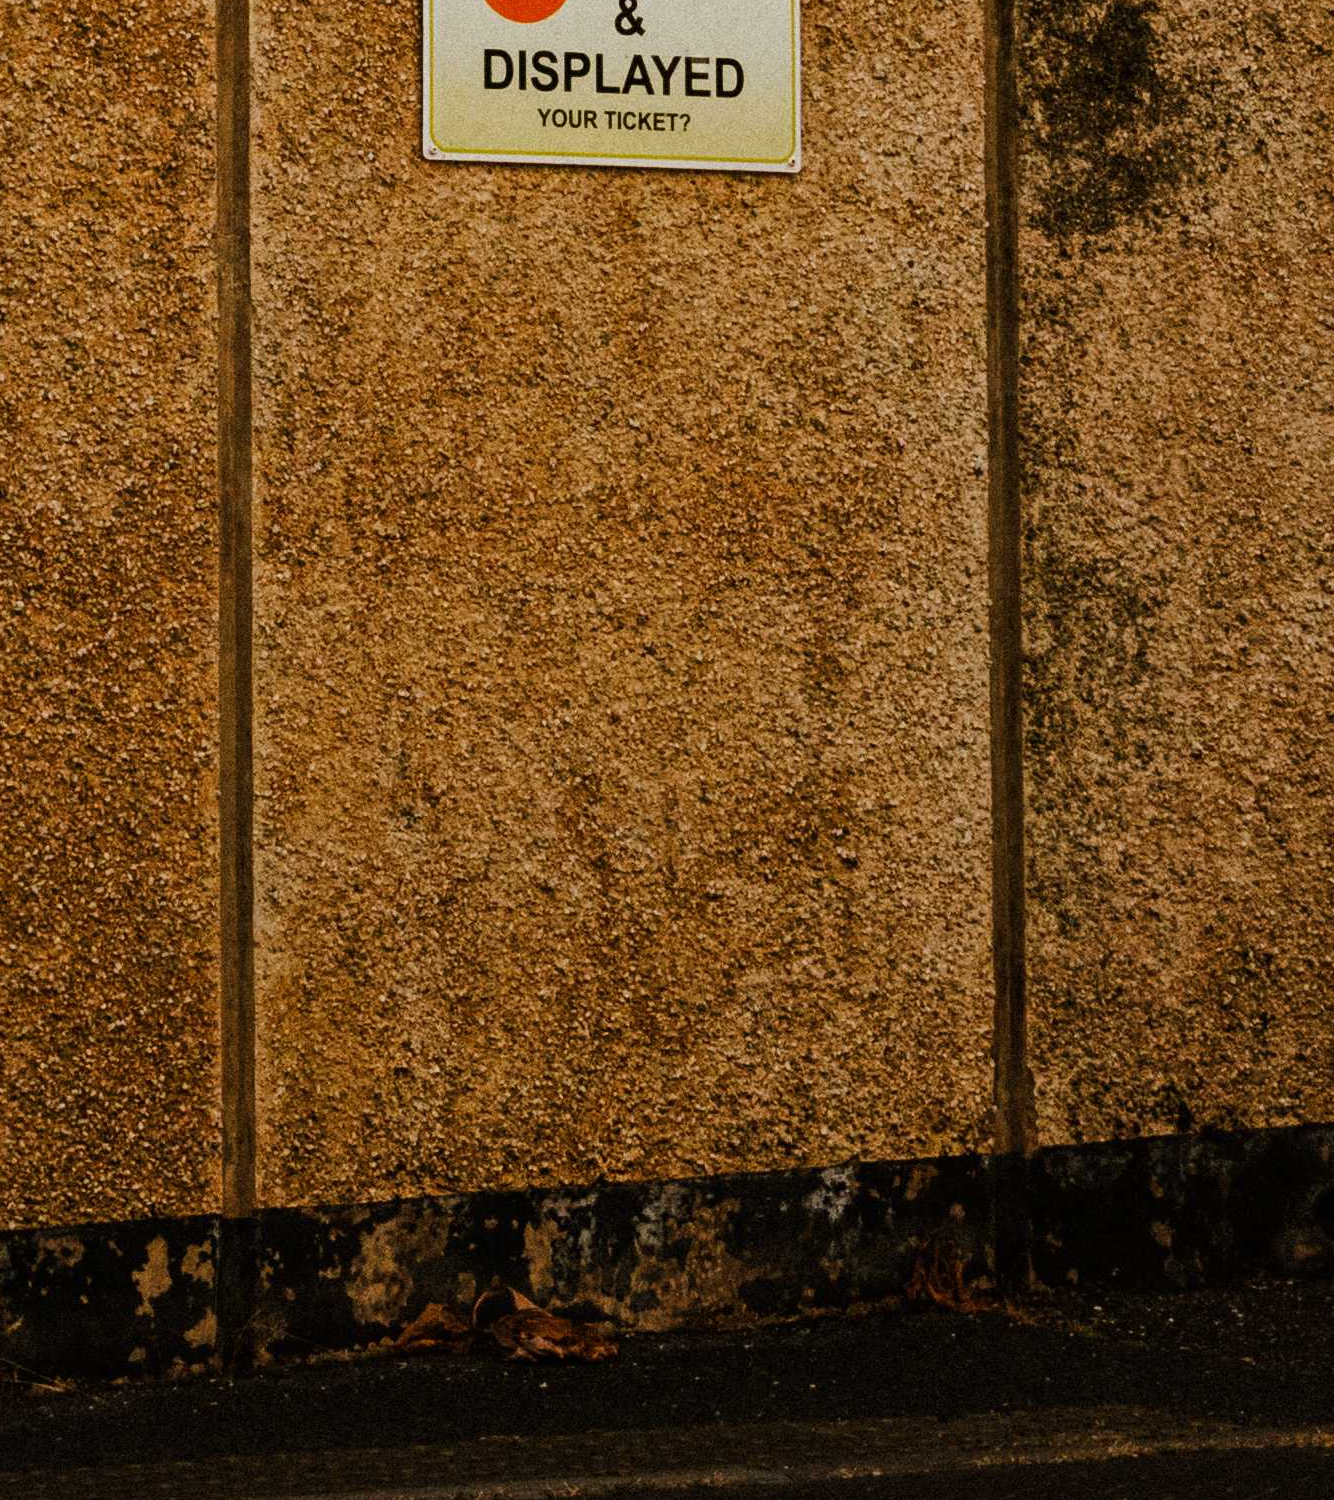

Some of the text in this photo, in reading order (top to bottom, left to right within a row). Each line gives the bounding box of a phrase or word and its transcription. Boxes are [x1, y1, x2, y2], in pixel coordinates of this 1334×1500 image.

[483, 48, 745, 99] DISPLAYED
[537, 108, 691, 132] YOUR TICKET?
